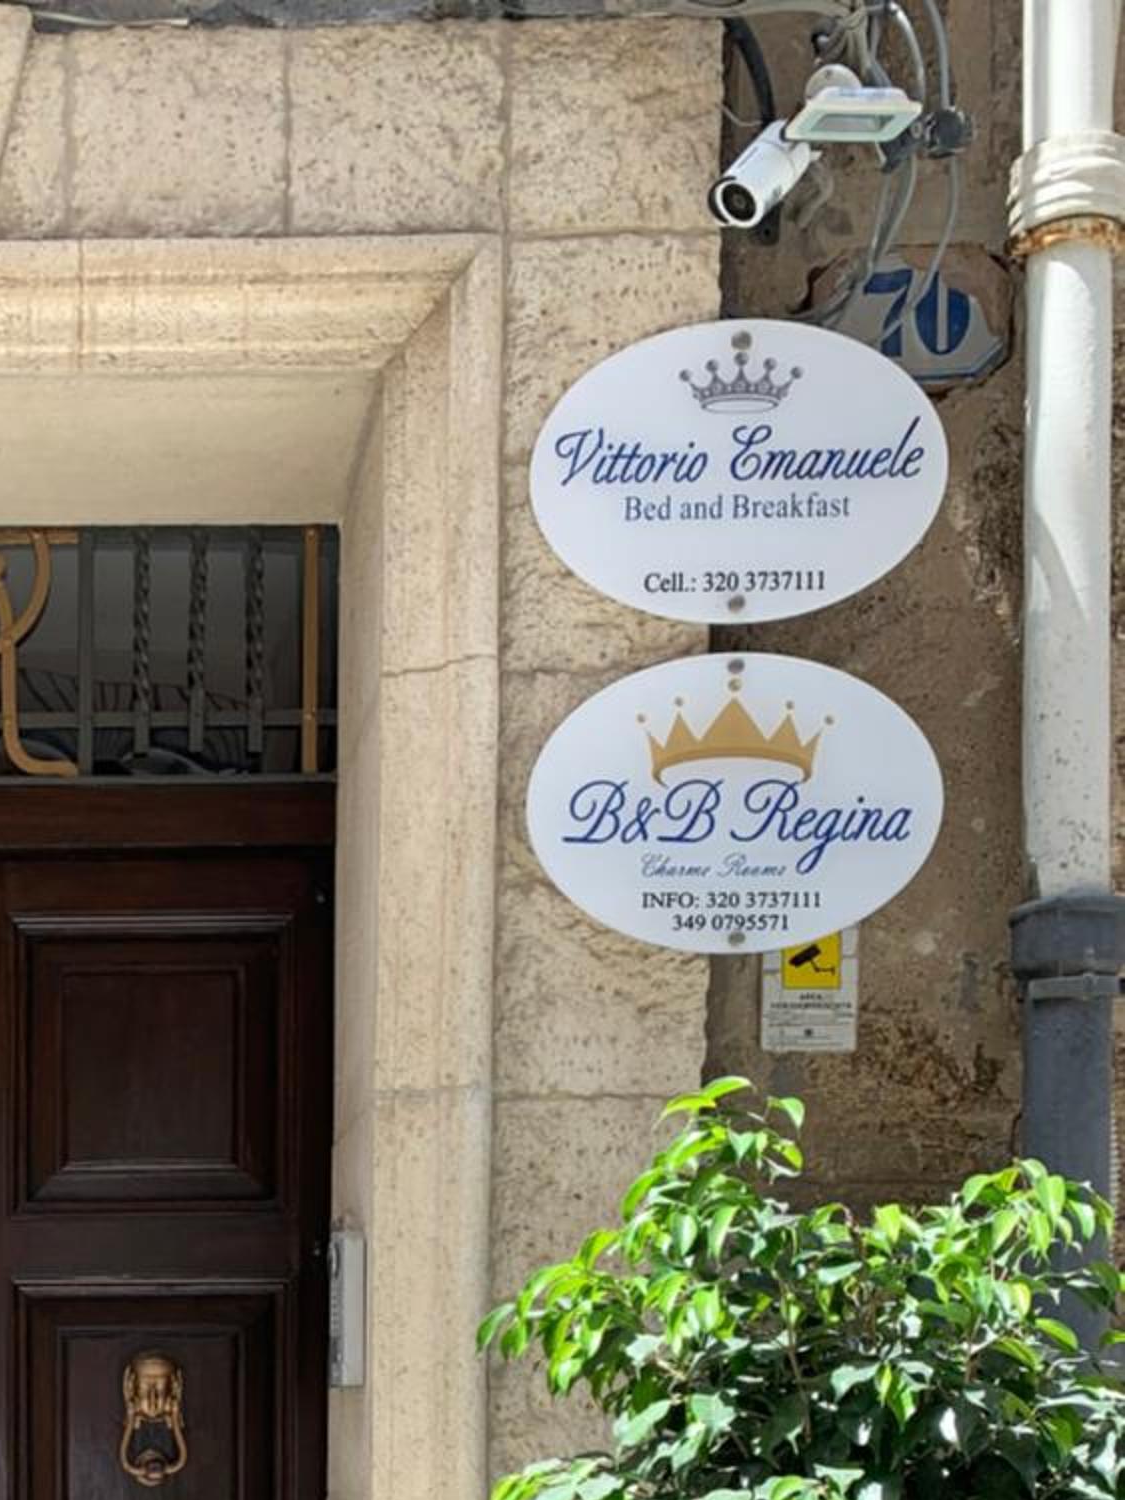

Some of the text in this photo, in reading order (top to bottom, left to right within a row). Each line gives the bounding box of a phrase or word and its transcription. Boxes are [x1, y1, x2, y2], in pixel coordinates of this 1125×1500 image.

[863, 268, 971, 357] 70
[555, 416, 925, 487] Vittorio Emanuele
[624, 492, 850, 521] Bed and Breakfast
[644, 570, 825, 592] Cell.: 320 3737111
[562, 780, 912, 874] B&B Regina
[641, 853, 786, 878] Charme Rooms
[642, 891, 821, 908] INFO: 320 3737111
[673, 914, 789, 930] 349 0795571
